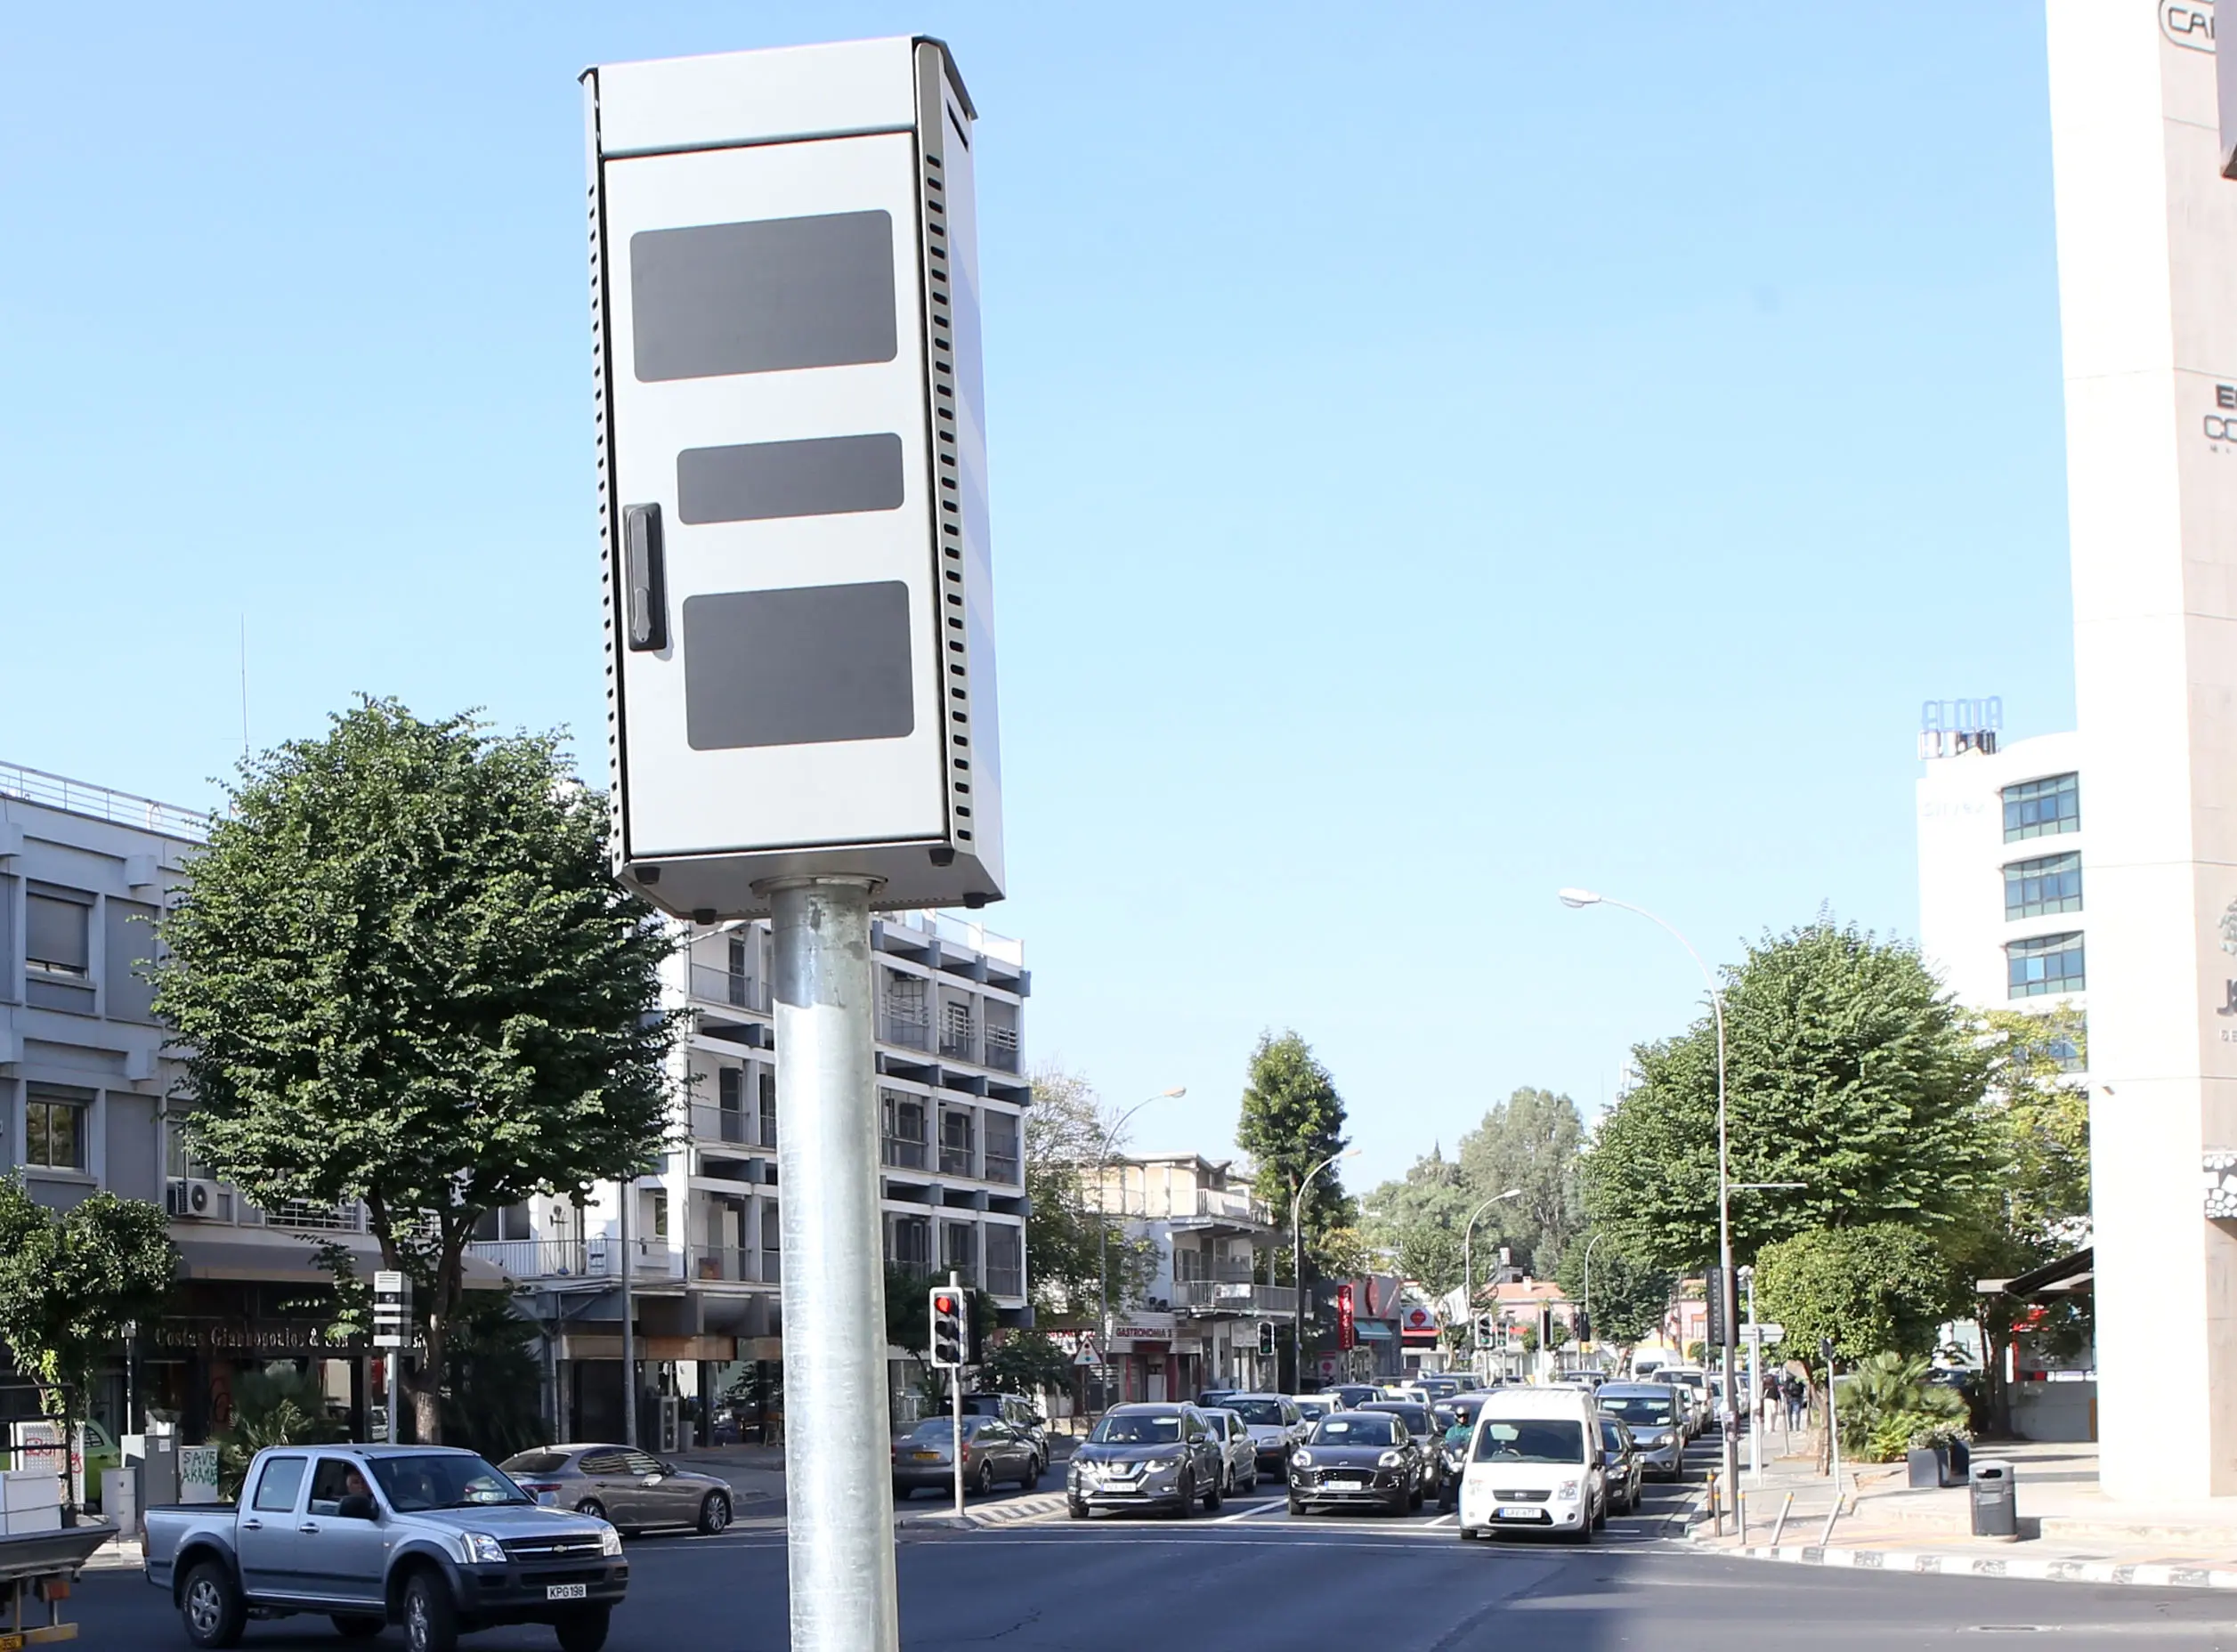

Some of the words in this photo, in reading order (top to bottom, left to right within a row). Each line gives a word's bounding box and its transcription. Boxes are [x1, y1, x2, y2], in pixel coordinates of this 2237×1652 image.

[2168, 6, 2216, 39] CA
[2215, 384, 2237, 409] E
[309, 1327, 320, 1347] &
[182, 1451, 217, 1467] SAVE
